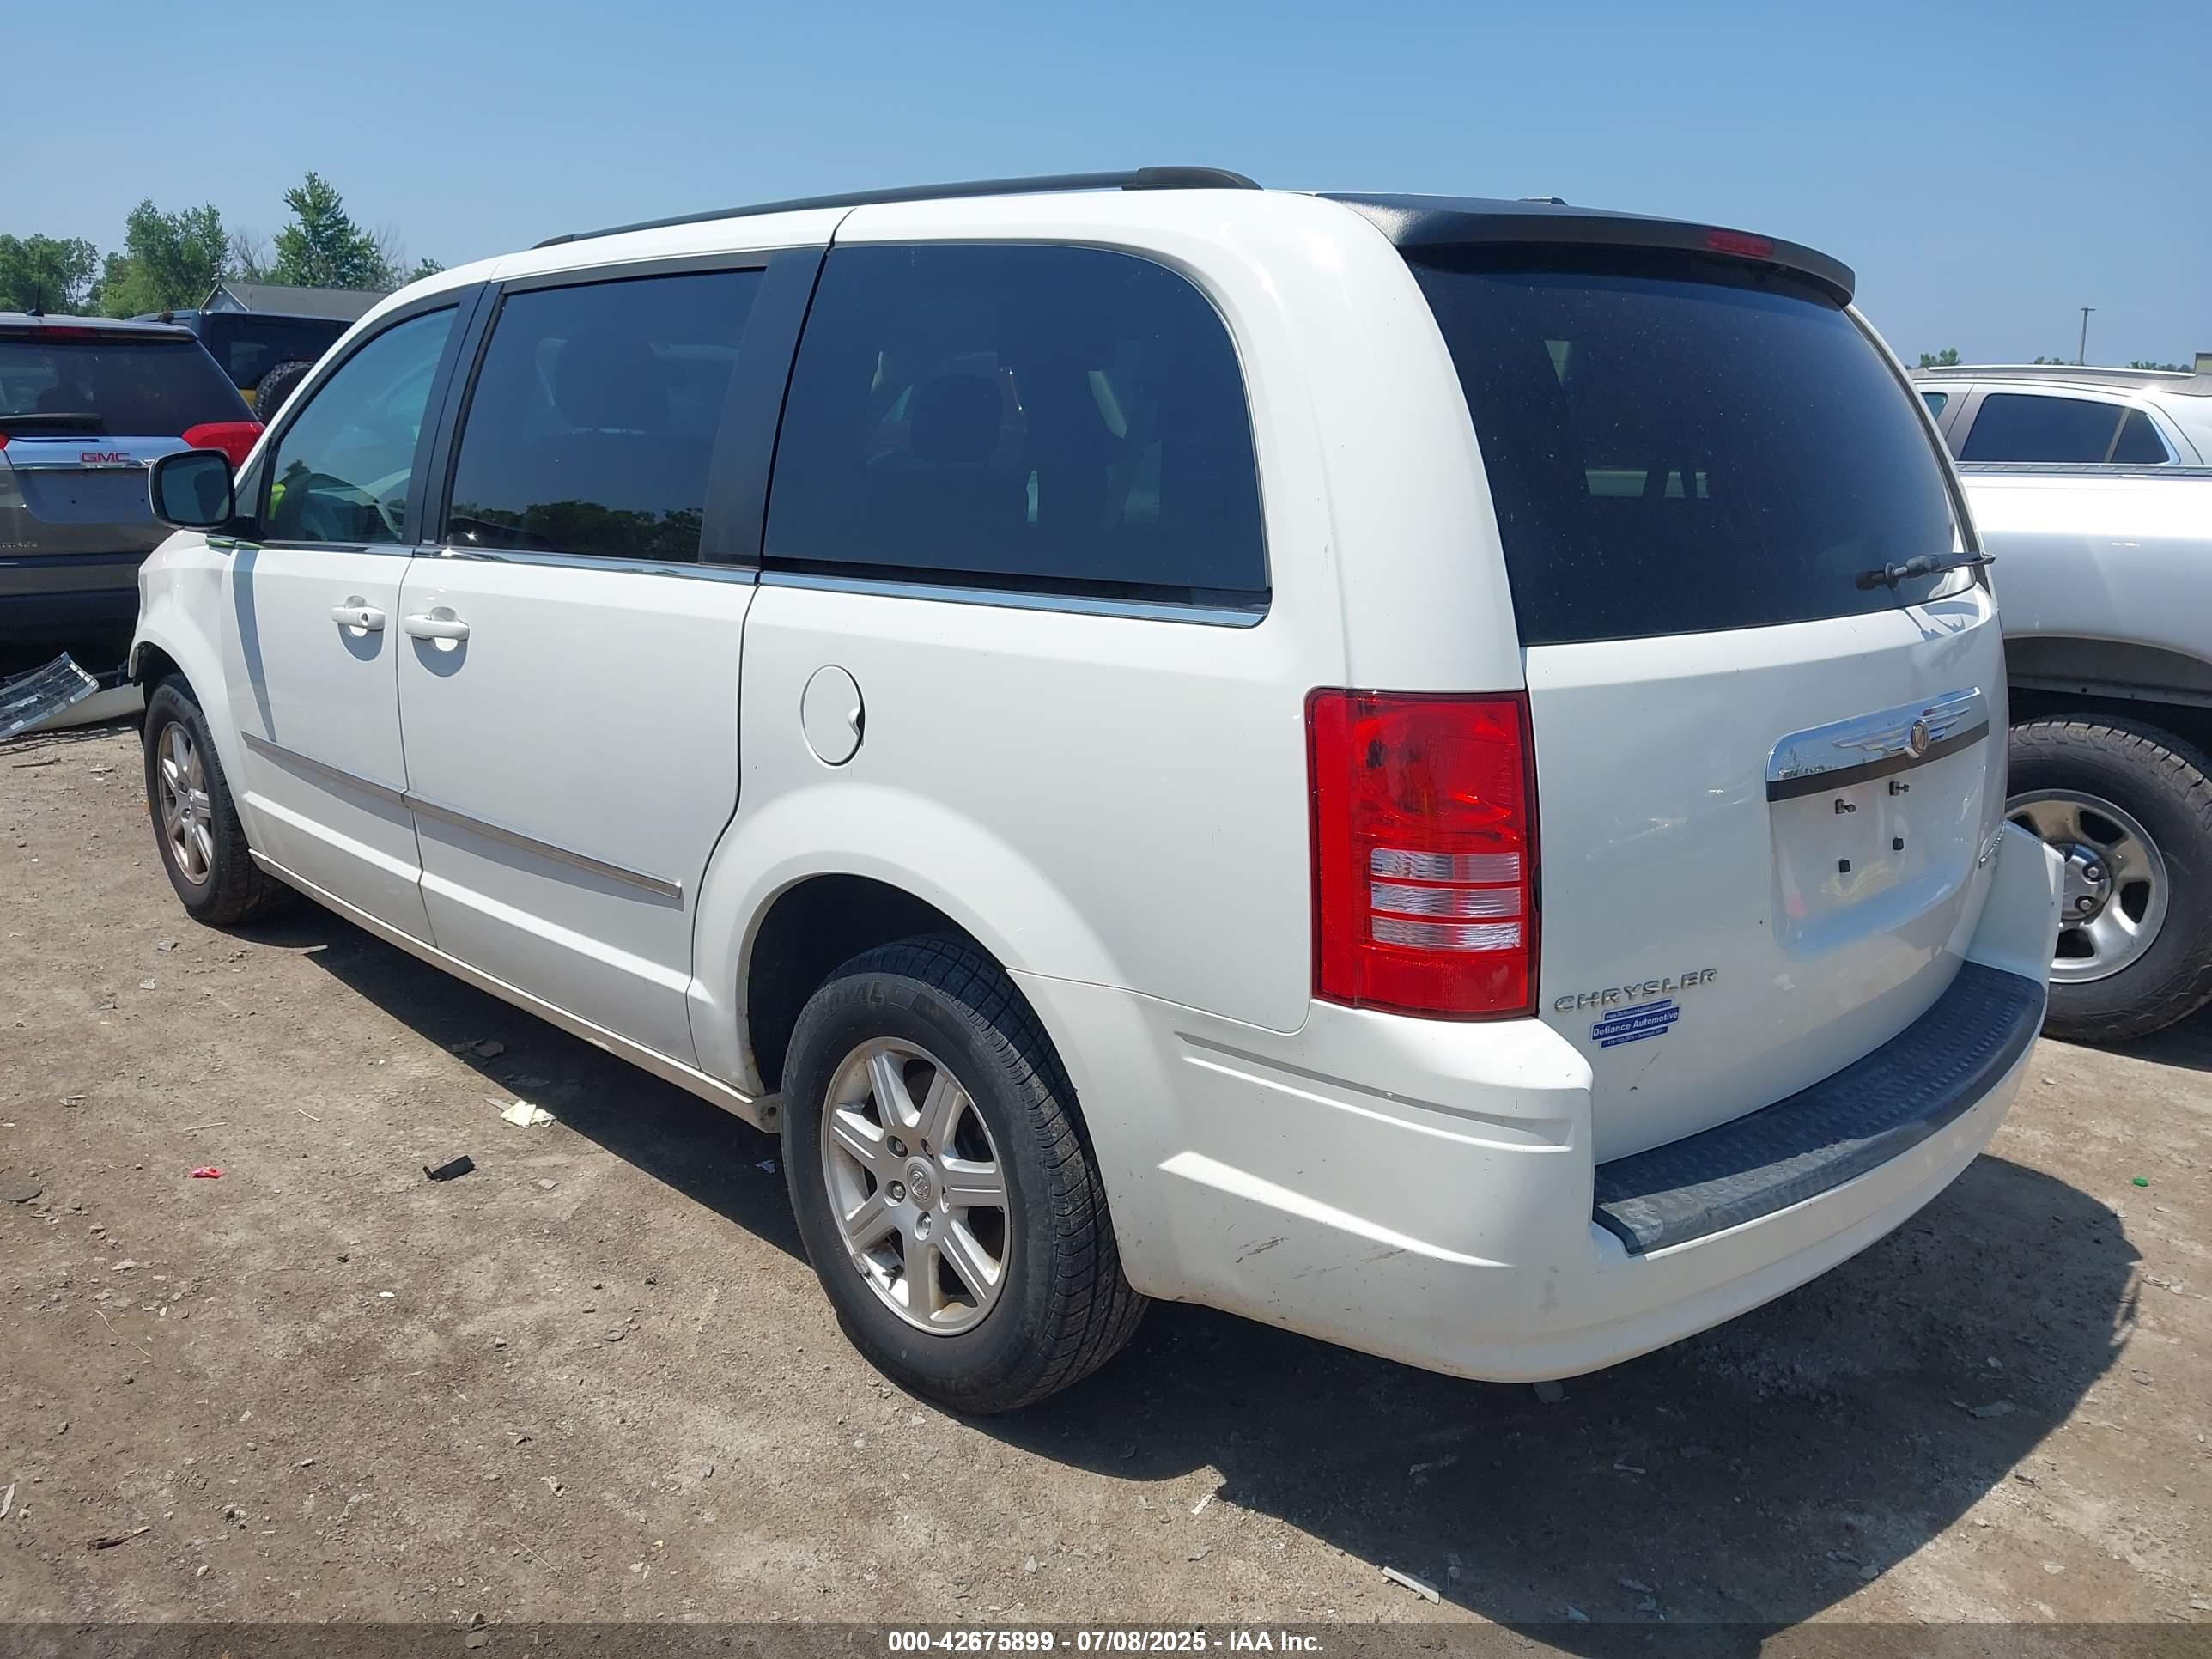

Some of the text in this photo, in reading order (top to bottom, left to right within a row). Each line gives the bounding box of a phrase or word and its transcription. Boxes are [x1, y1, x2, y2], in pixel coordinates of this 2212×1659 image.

[80, 452, 131, 462] GMC
[1554, 968, 1717, 1012] CHRYSLER
[1593, 1011, 1678, 1036] Defiance Automotive
